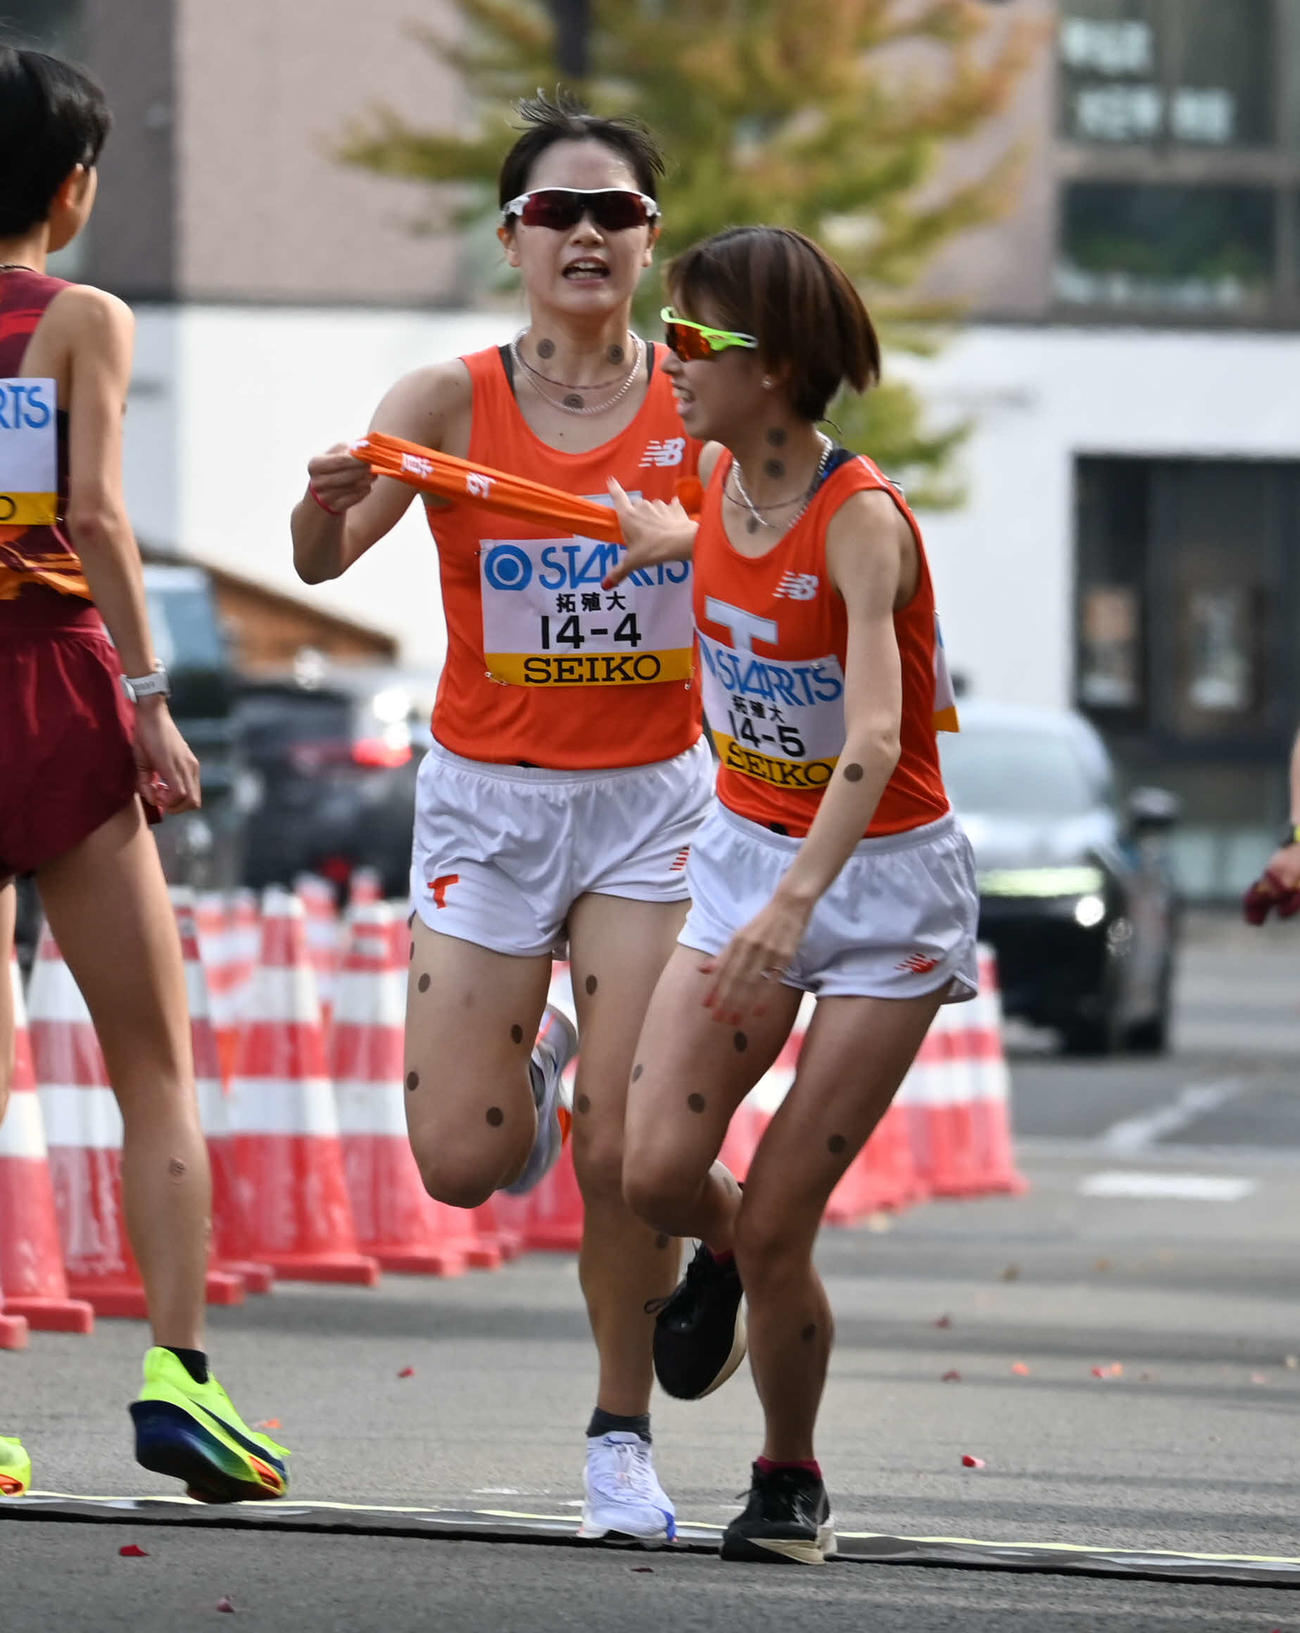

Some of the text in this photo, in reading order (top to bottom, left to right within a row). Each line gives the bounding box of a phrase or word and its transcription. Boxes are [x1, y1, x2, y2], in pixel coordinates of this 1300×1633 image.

[556, 591, 626, 613] 拓殖大
[541, 613, 642, 650] 14-4
[524, 655, 661, 684] SEIKO
[716, 650, 842, 706] STARTS
[728, 710, 805, 758] 14-5
[727, 742, 834, 786] SEIKO
